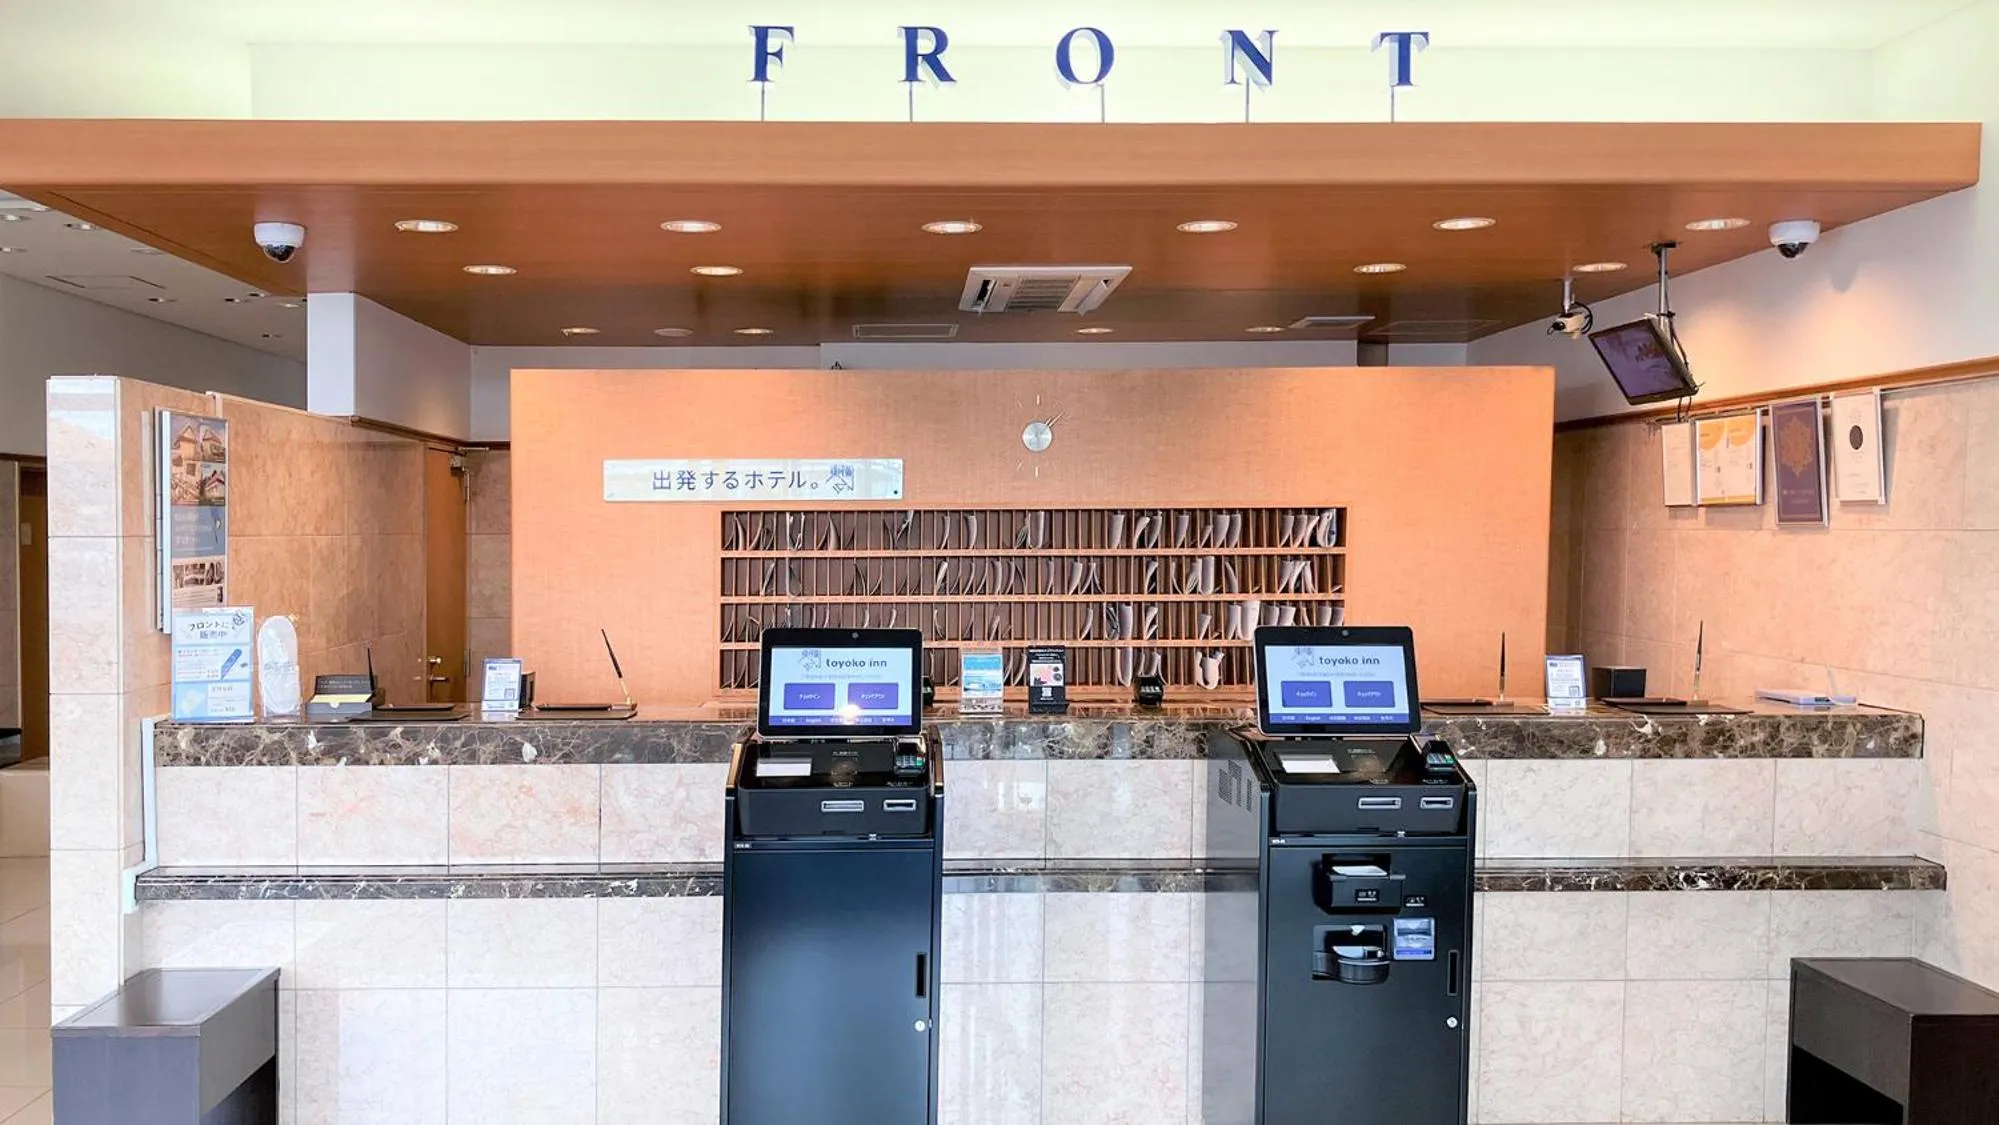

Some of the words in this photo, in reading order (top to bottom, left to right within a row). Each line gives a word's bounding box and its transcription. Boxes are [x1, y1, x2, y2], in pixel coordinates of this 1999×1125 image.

[748, 25, 1429, 87] FRONT
[652, 469, 820, 491] 出発するホテル。
[826, 657, 866, 669] toyoko
[869, 657, 887, 668] inn
[1319, 655, 1359, 667] toyoko
[1361, 655, 1380, 666] inn
